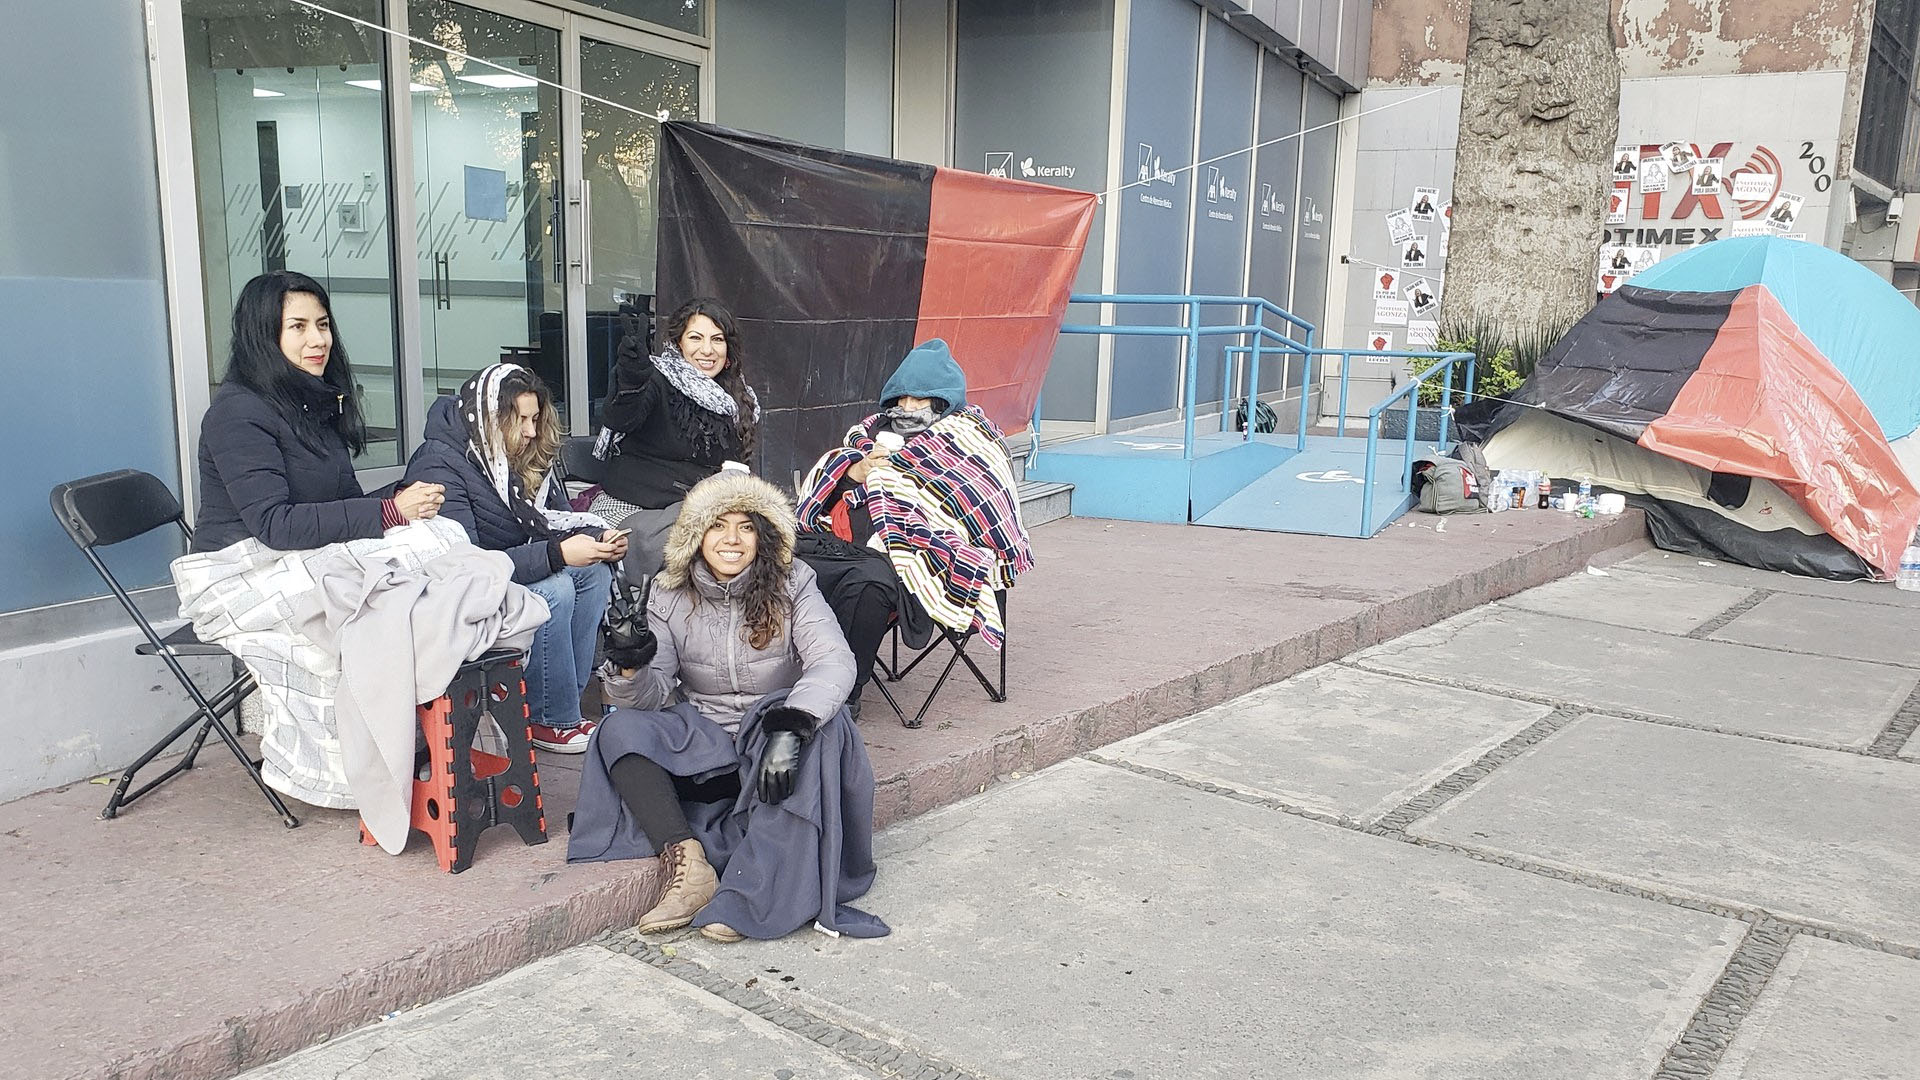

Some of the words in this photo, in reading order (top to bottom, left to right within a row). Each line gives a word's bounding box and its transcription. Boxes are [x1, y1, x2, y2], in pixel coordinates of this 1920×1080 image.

[1037, 165, 1076, 179] Keralty
[1798, 141, 1831, 194] 200
[1735, 186, 1772, 194] AGONIZA
[1376, 310, 1407, 318] AGONIZA
